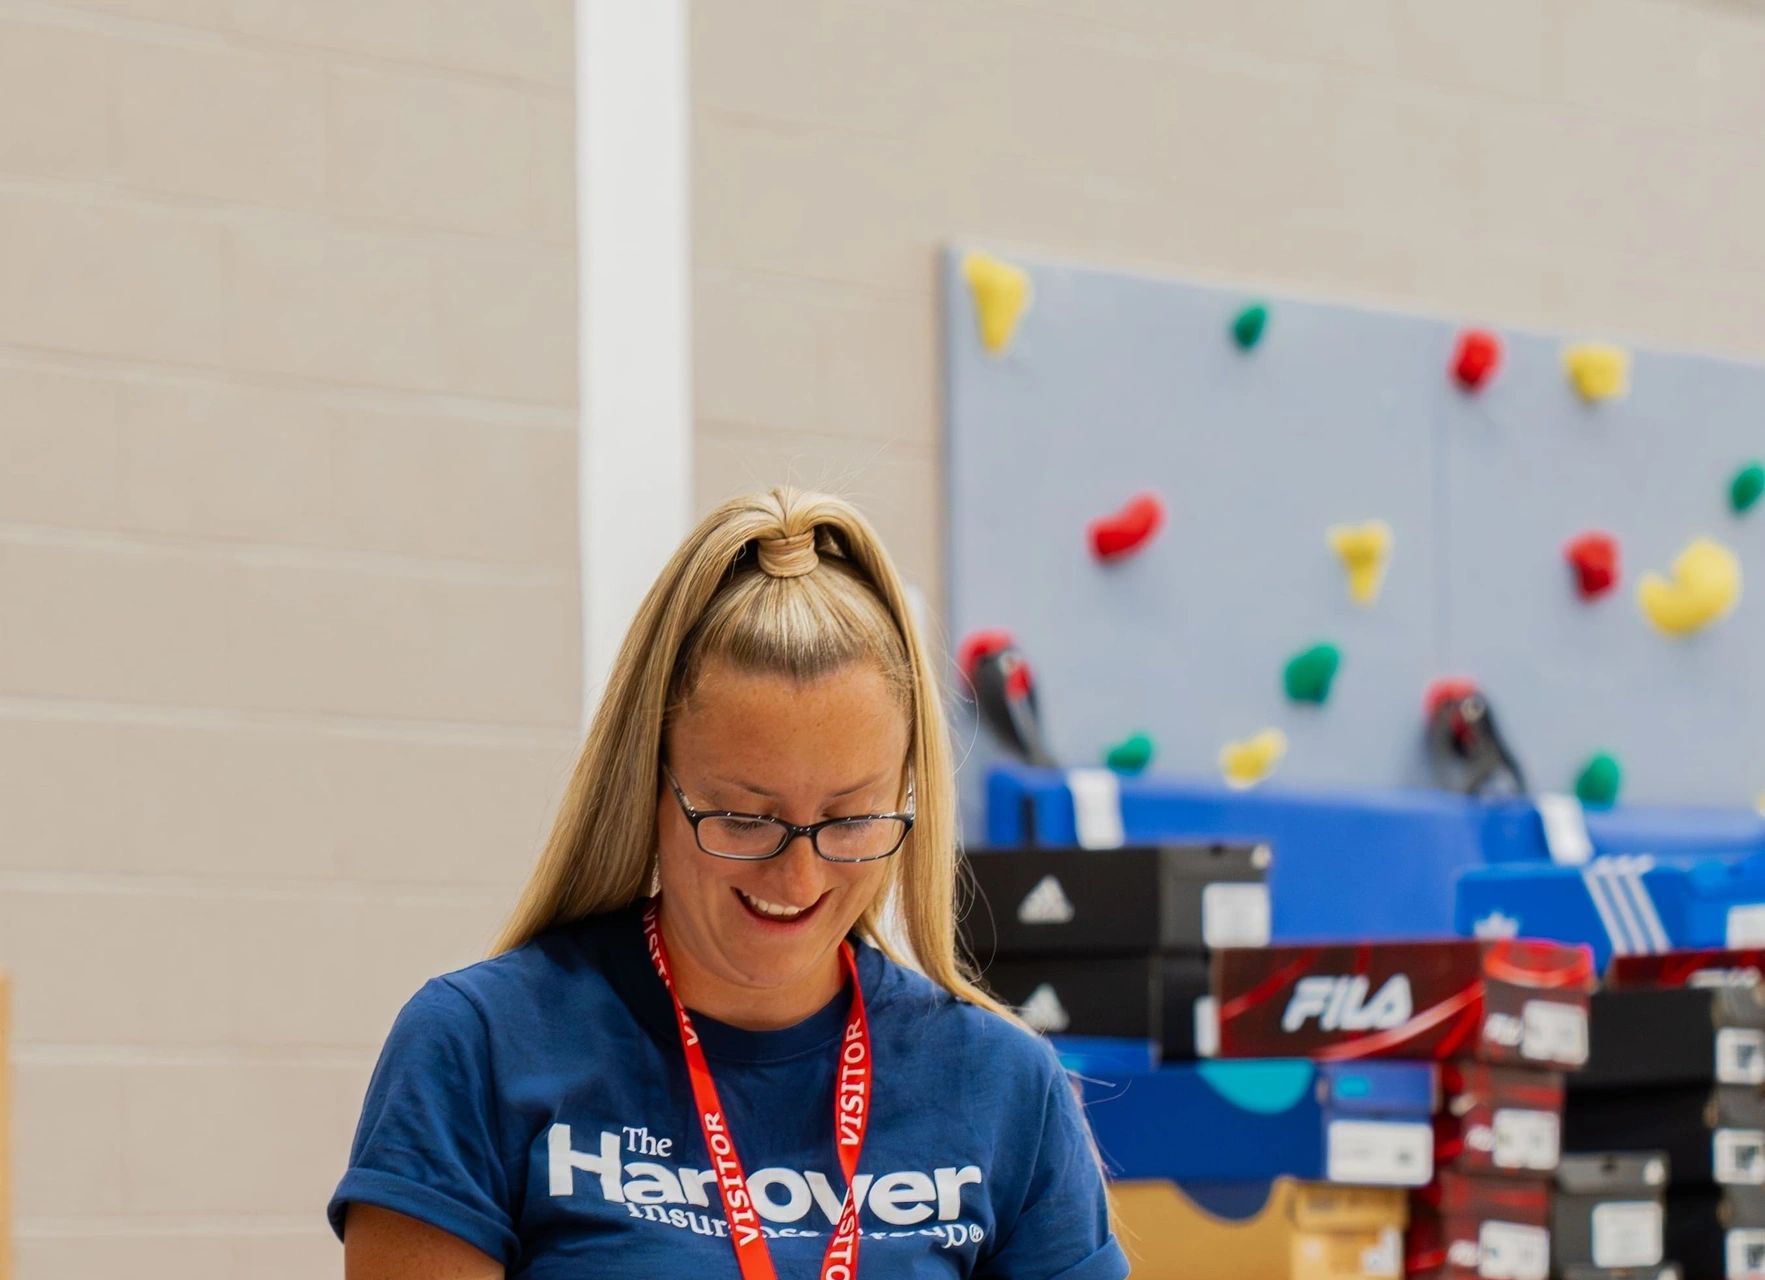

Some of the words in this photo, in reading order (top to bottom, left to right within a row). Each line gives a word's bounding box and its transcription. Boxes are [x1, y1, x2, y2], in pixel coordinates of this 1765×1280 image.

[1282, 973, 1412, 1034] FILA
[840, 1018, 865, 1146] VISITOR
[622, 1126, 673, 1157] The
[705, 1112, 760, 1247] VISITOR
